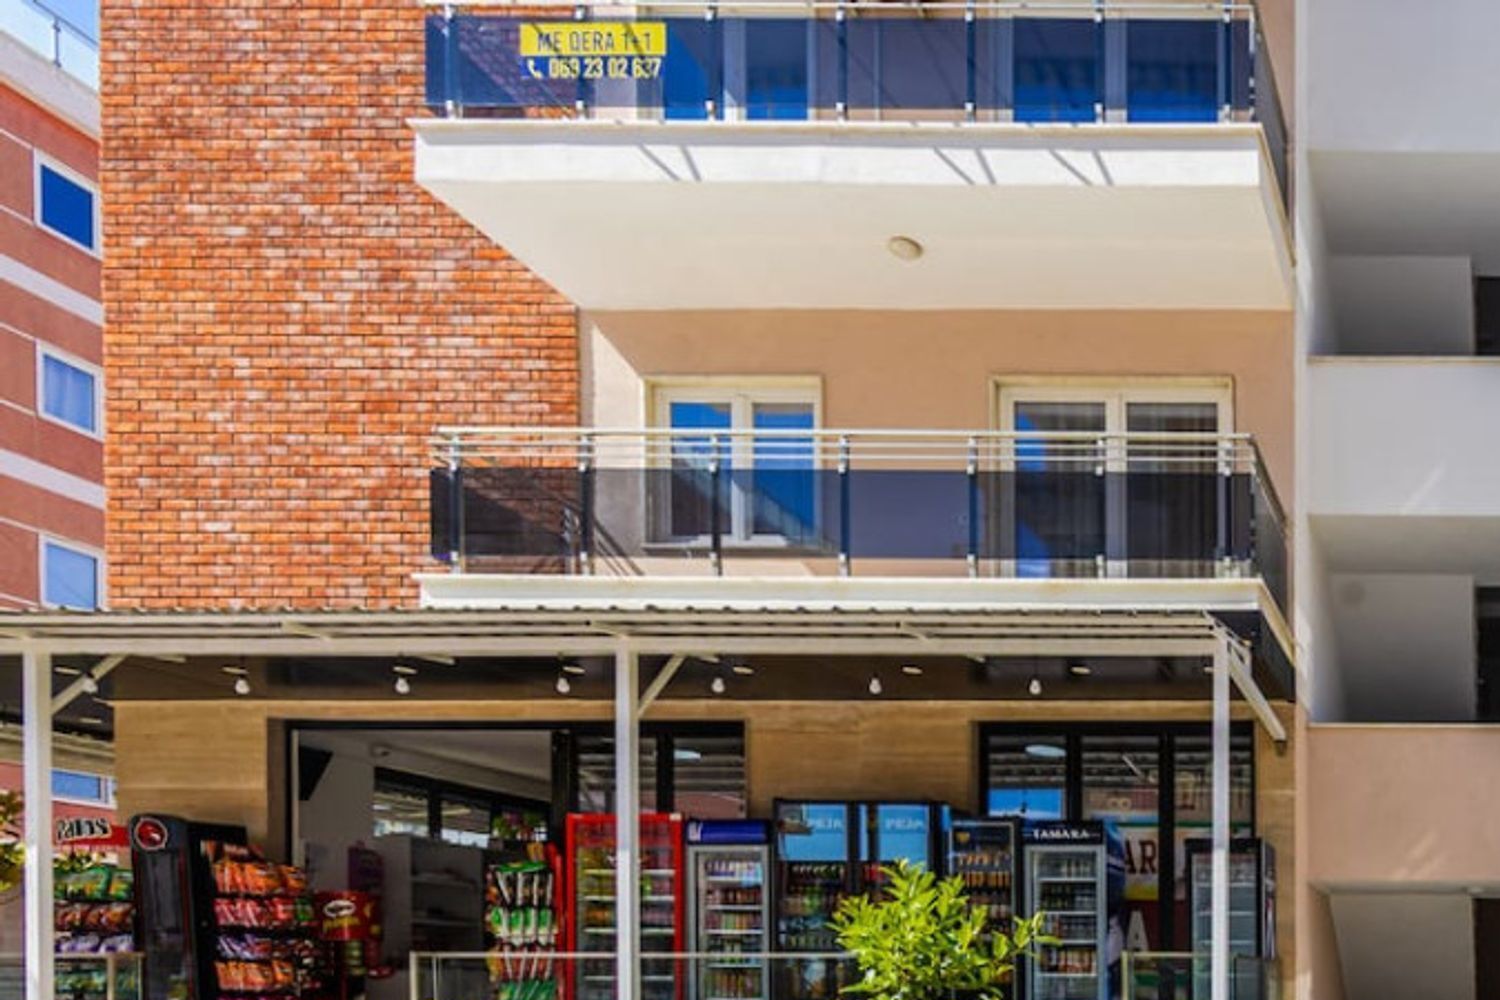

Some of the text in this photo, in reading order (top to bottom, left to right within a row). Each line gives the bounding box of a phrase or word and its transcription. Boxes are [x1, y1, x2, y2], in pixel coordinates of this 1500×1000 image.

[538, 31, 563, 52] ME
[583, 56, 604, 79] 23
[607, 57, 628, 79] 02
[1033, 828, 1091, 841] TAMARA
